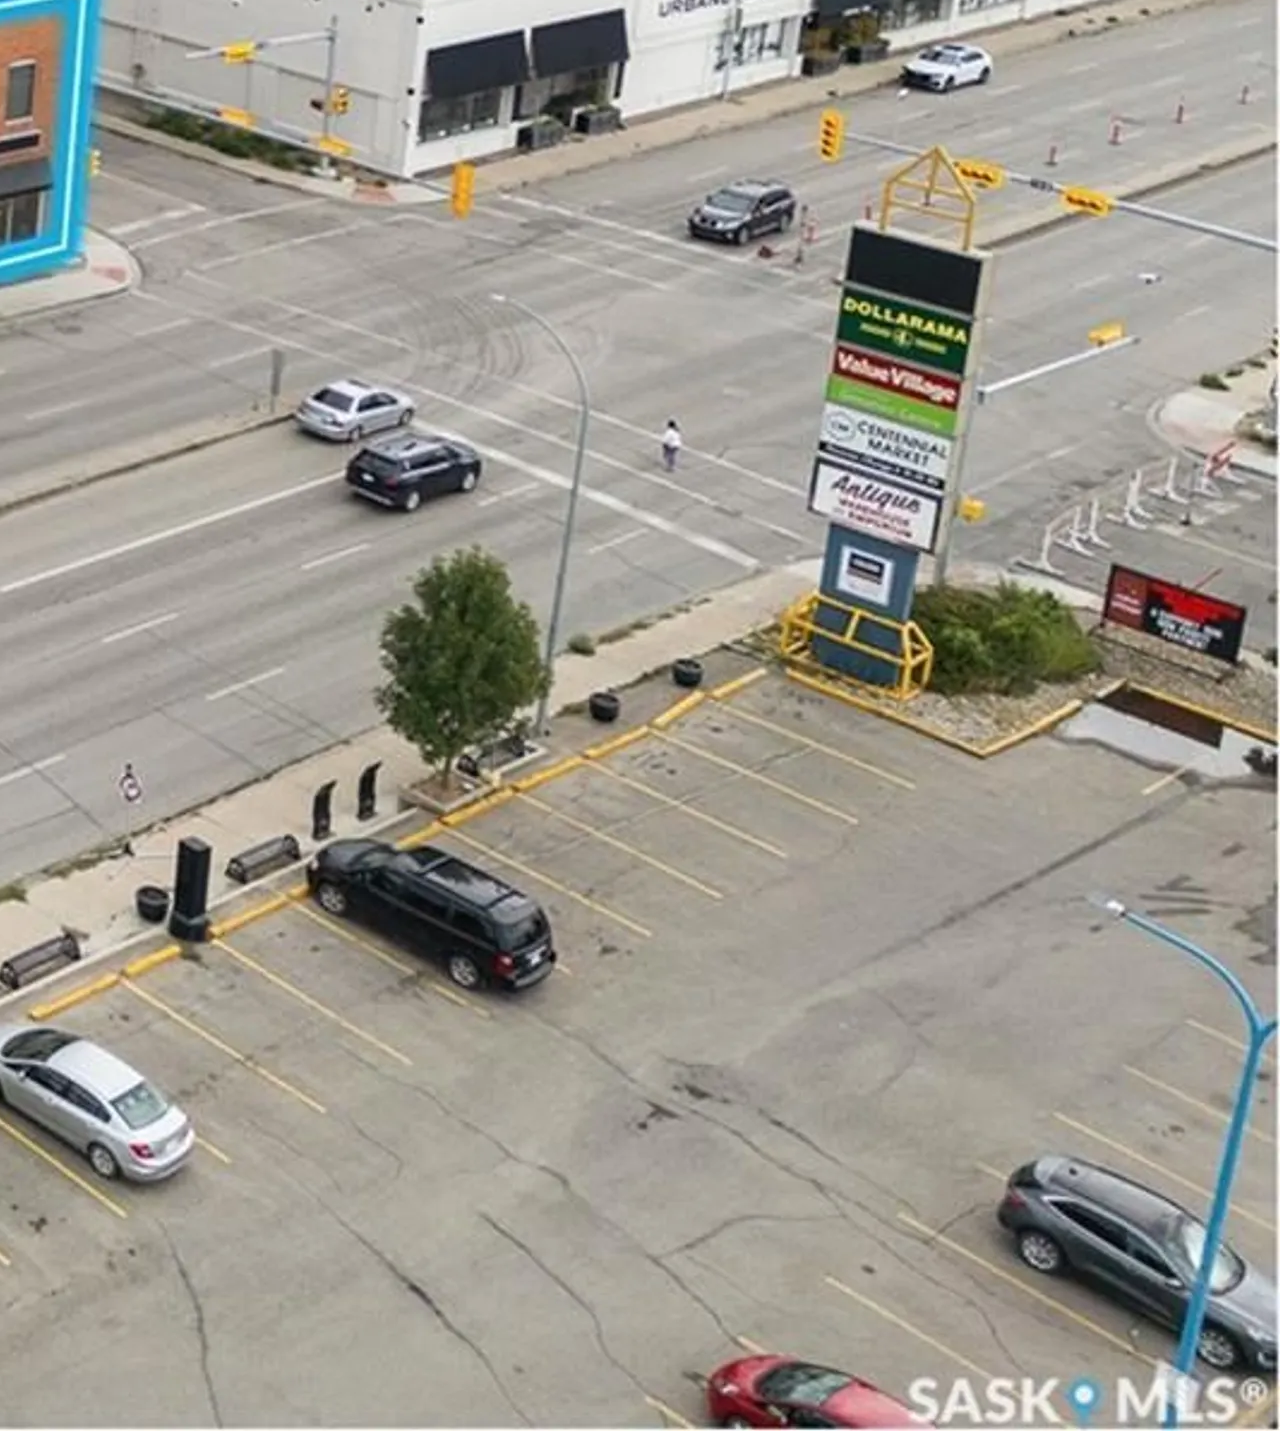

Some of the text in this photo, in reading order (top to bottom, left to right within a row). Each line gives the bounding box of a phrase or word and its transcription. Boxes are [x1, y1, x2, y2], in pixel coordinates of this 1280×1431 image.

[843, 296, 968, 345] DOLLARAMA
[838, 352, 957, 404] Value Village
[857, 420, 947, 460] CENTENNIAL
[868, 439, 929, 466] MARKET
[831, 474, 922, 514] Antique
